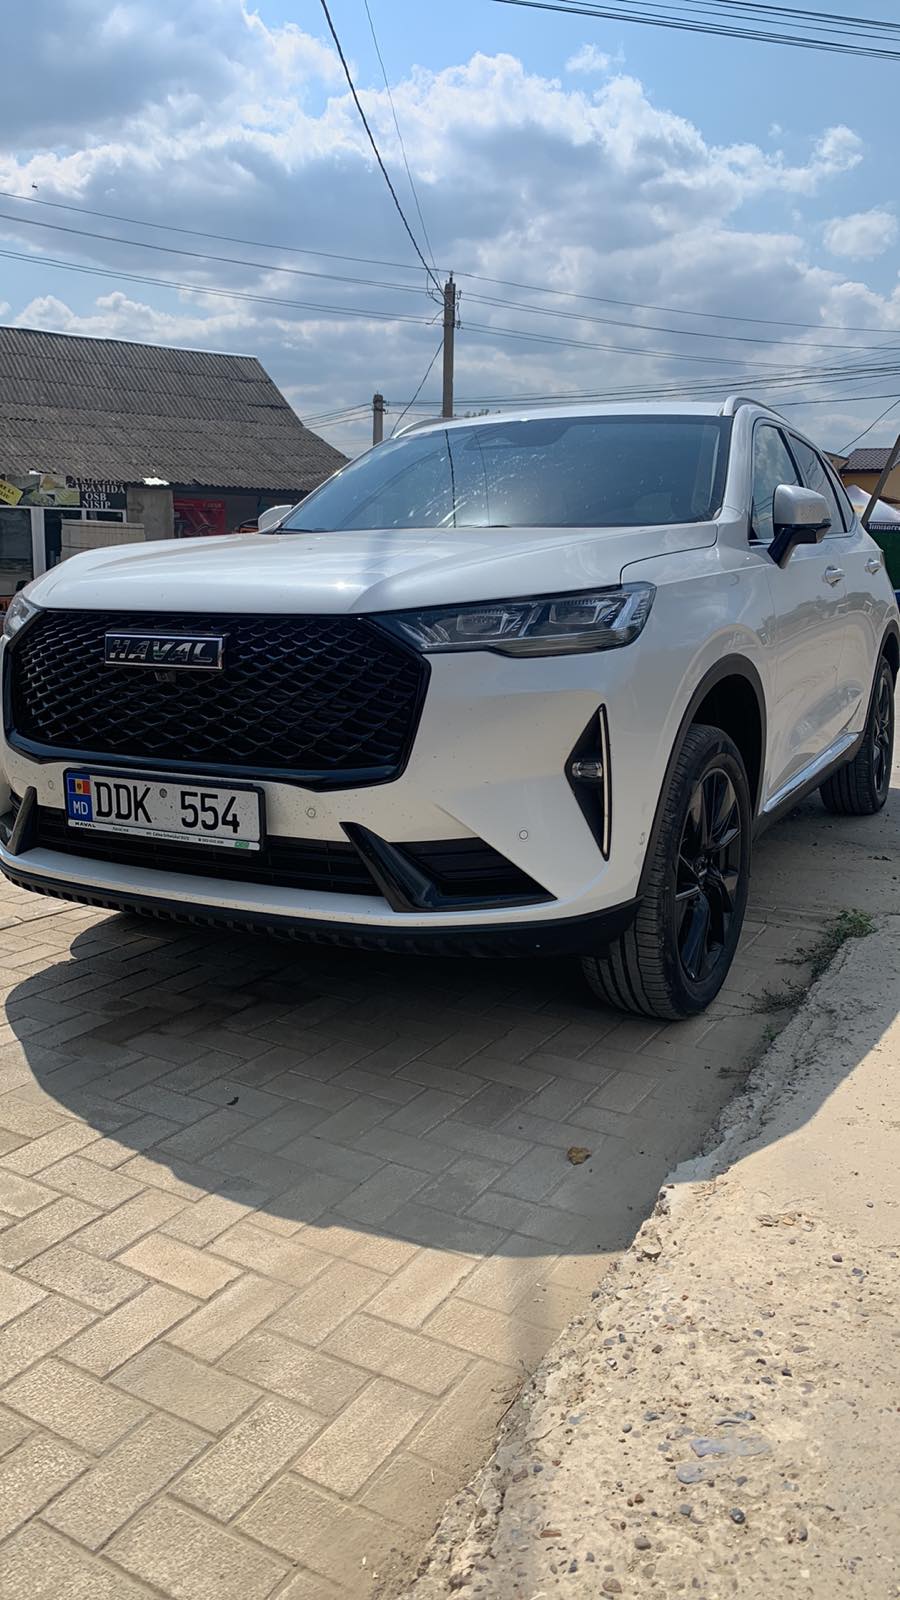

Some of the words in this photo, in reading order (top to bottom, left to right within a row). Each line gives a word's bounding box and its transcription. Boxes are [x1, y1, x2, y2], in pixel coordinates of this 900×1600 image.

[85, 492, 107, 501] OSB
[82, 500, 111, 509] NISIP
[109, 639, 213, 663] HAVAL
[73, 801, 88, 815] MD
[94, 781, 152, 823] DDK
[180, 790, 240, 833] 554
